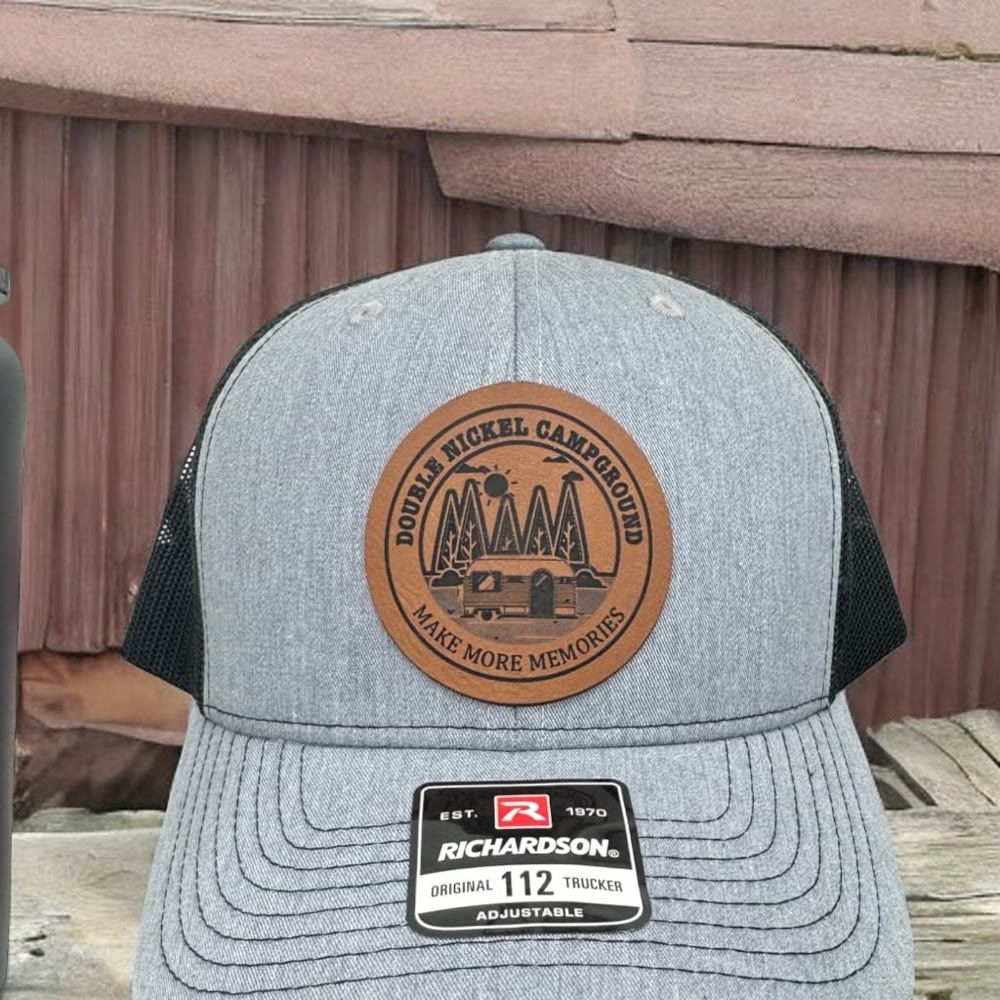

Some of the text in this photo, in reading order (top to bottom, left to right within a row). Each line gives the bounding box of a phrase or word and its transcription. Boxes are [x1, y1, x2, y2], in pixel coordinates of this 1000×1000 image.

[396, 417, 643, 546] DOUBLE NICKEL CAMPGROUND
[412, 604, 626, 672] MAKE MORE MEMORIES
[440, 810, 478, 821] EST.
[566, 807, 607, 817] 1970
[431, 870, 623, 898] ORIGINAL 112 TRUCKER
[476, 908, 584, 921] ADJUSTABLE
